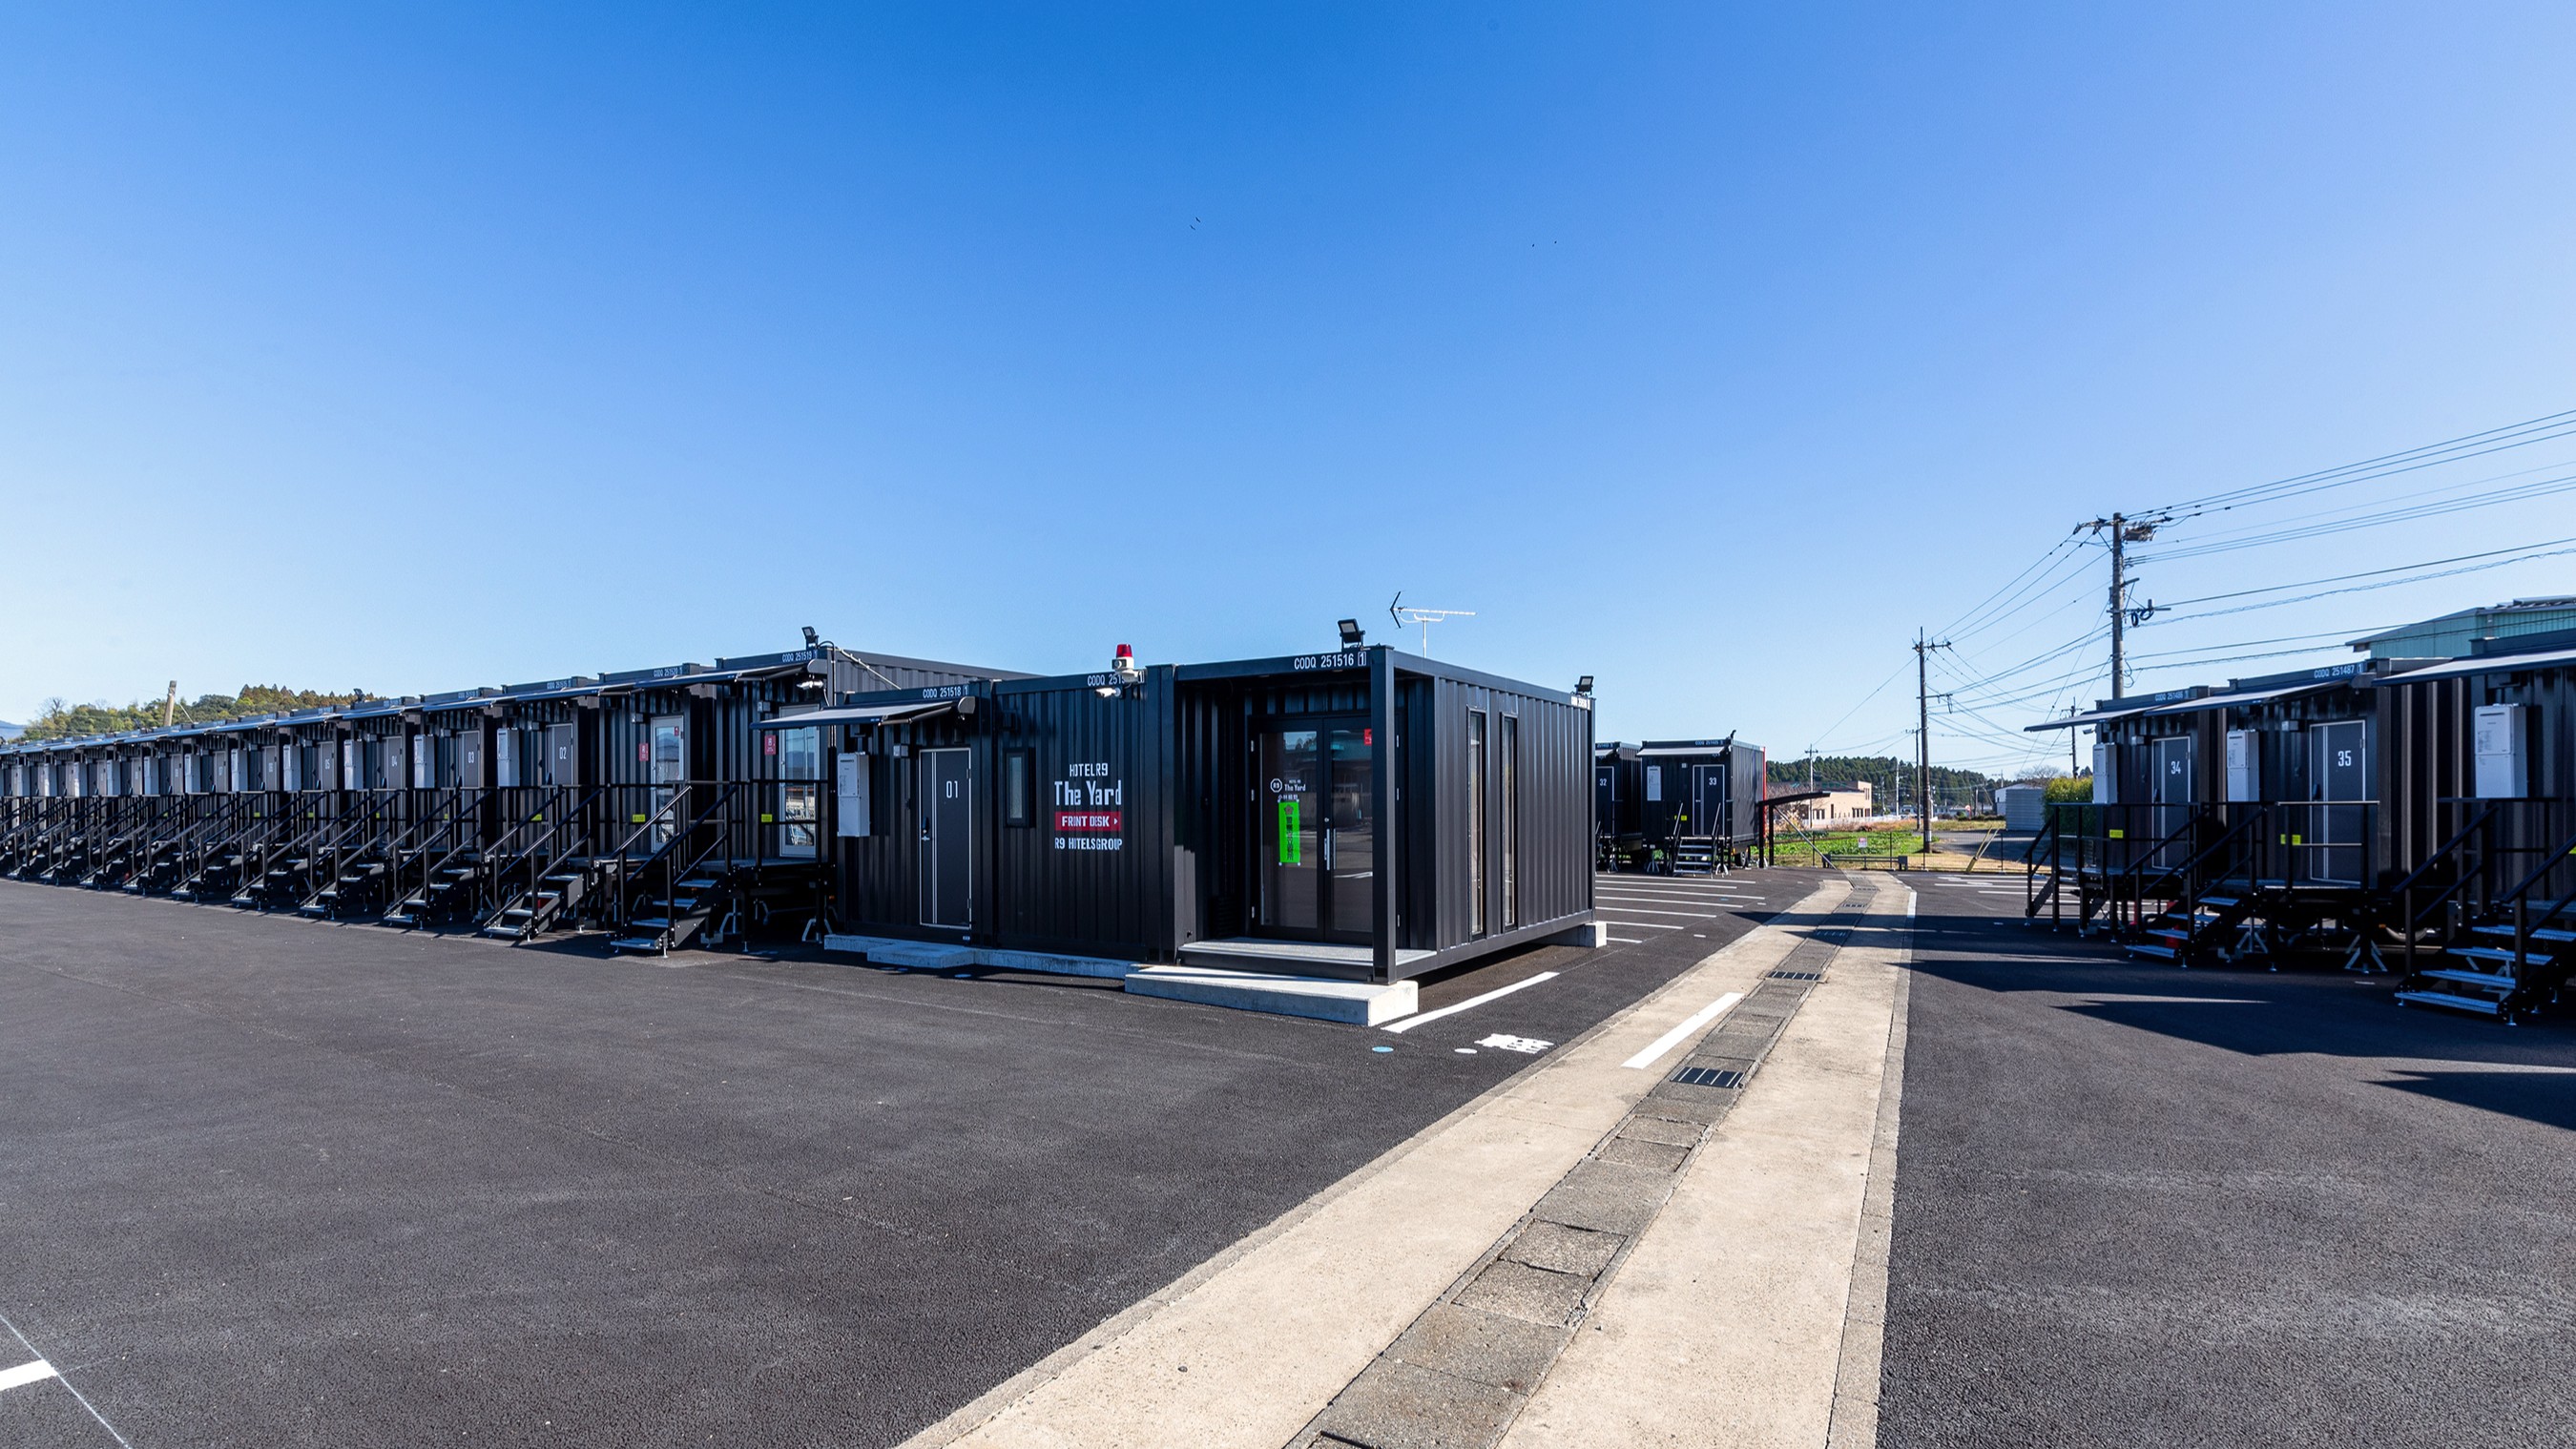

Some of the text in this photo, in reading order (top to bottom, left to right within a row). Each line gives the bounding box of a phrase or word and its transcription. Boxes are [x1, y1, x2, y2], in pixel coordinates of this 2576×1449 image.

[1294, 657, 1317, 670] CODQ
[1320, 653, 1355, 668] 251516
[1088, 674, 1106, 686] CODQ
[940, 686, 962, 697] 251518
[467, 752, 475, 763] 03
[559, 747, 567, 760] 02
[2337, 750, 2352, 767] 35
[2171, 761, 2181, 775] 34
[1599, 778, 1608, 787] 32
[1709, 777, 1717, 786] 33
[945, 780, 959, 798] 01
[1054, 779, 1122, 806] The Yard
[1090, 816, 1110, 827] DESK
[1054, 838, 1066, 849] R9
